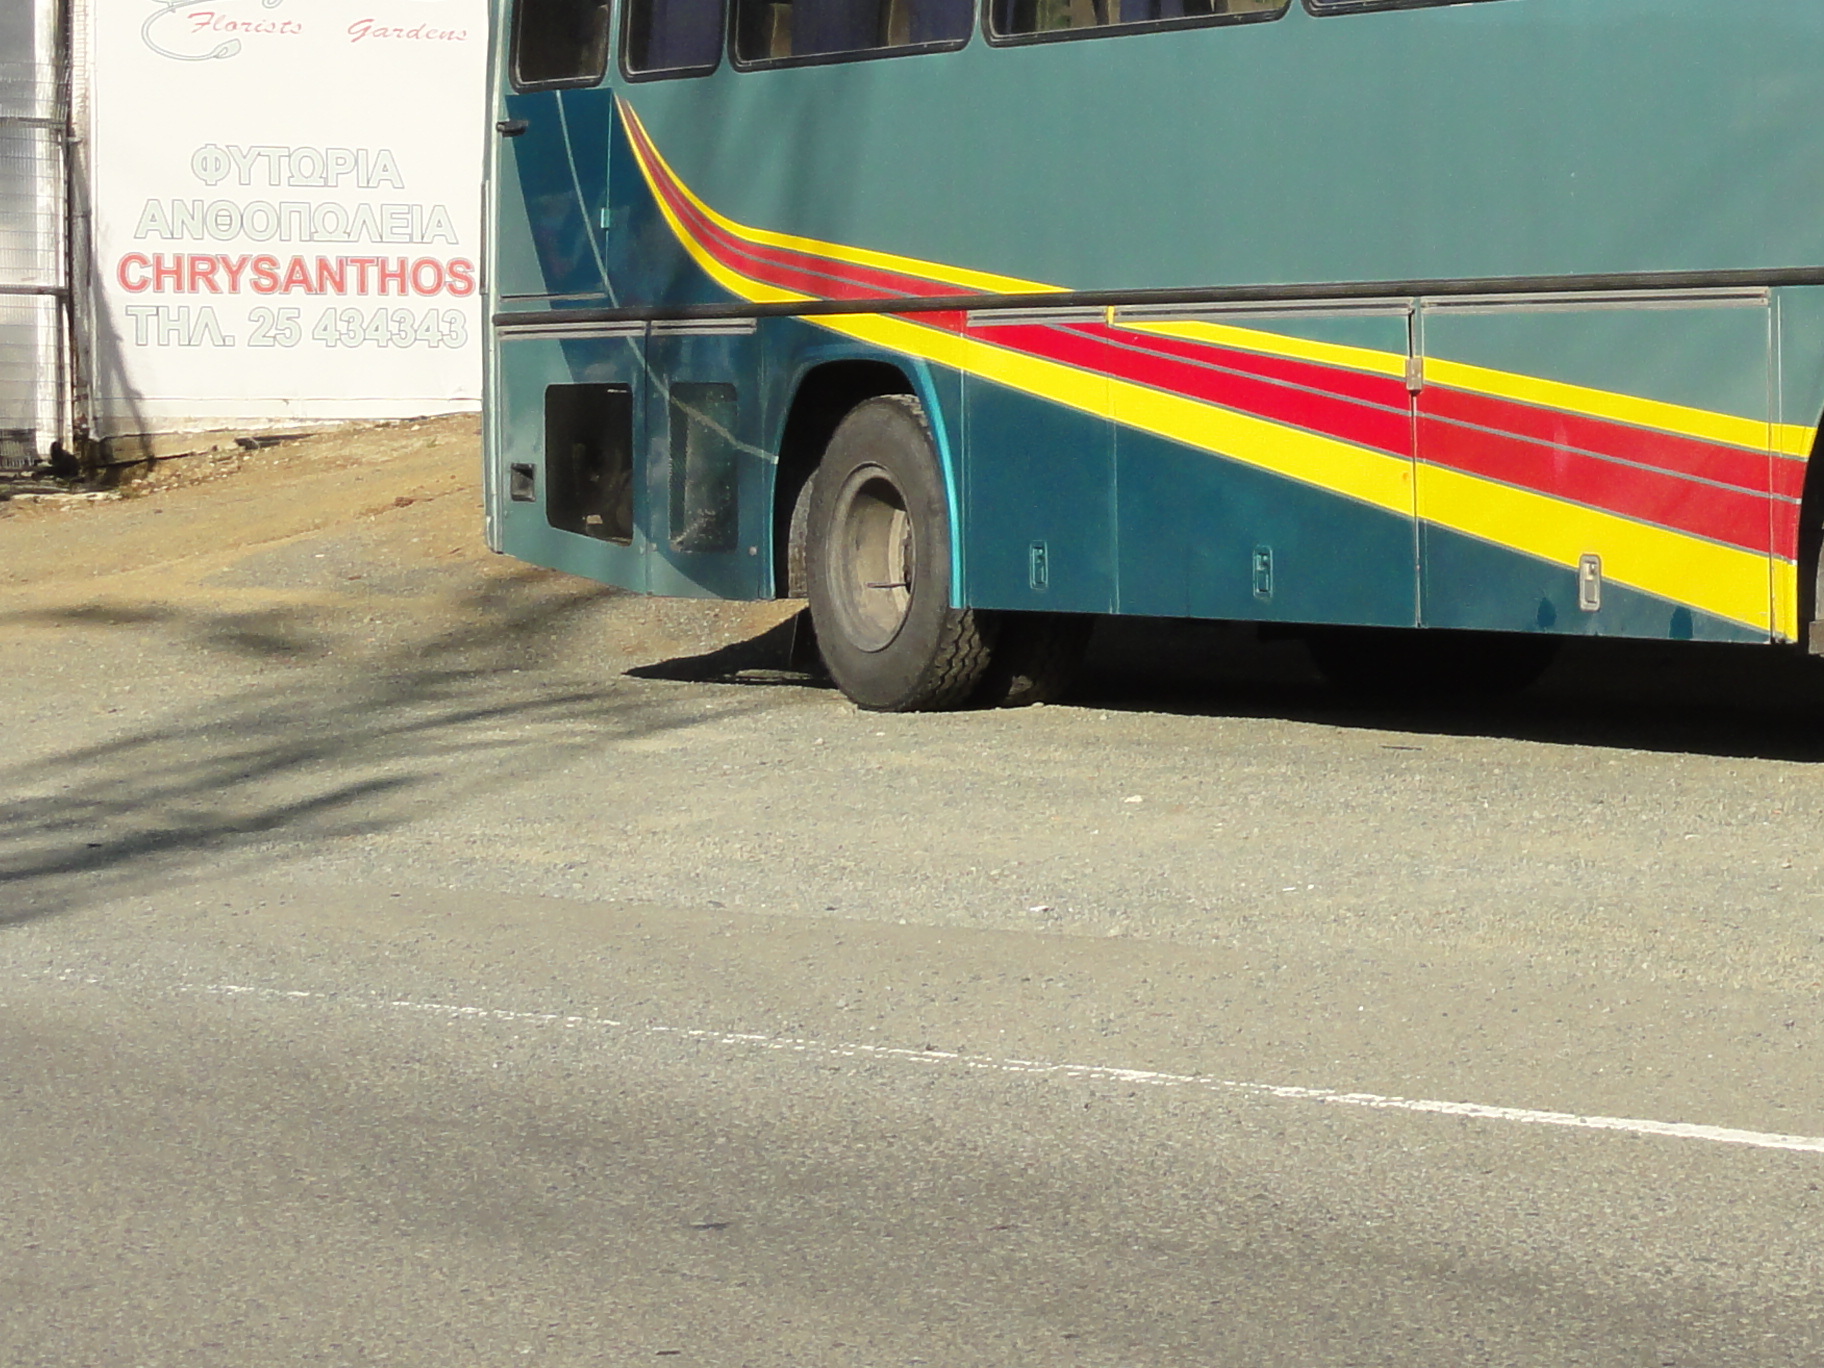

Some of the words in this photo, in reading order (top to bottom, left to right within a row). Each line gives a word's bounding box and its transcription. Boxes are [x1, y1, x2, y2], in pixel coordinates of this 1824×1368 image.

[187, 12, 302, 34] Florists
[347, 18, 467, 43] Gardens
[191, 144, 405, 189] ΦΥΤΩΡΙΑ
[133, 199, 459, 245] ΑΝΘΟΠΩΛΕΙΑ
[116, 251, 476, 297] CHRYSANTHOS
[125, 305, 236, 347] ΤΗΛ.
[248, 307, 301, 348] 25
[312, 307, 468, 349] 434343
